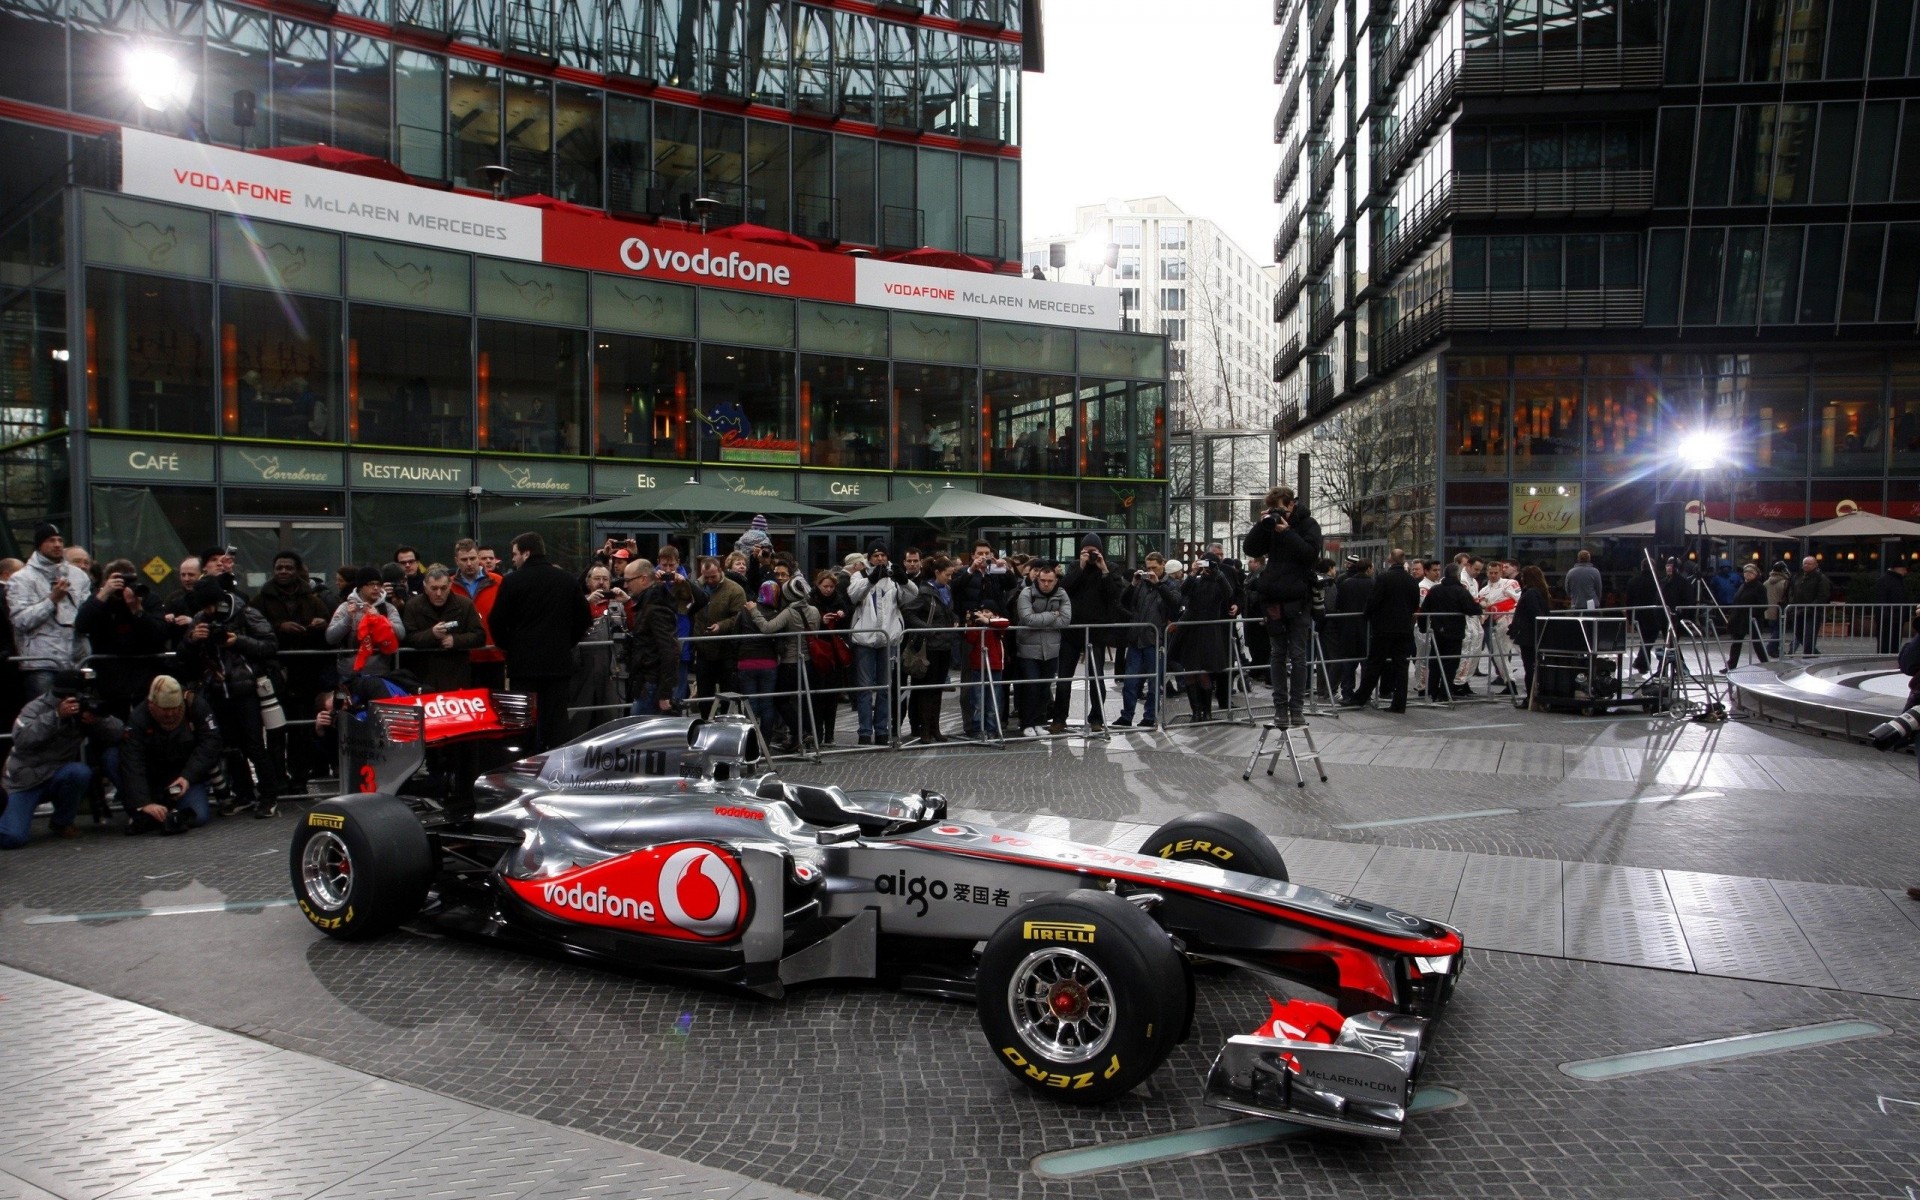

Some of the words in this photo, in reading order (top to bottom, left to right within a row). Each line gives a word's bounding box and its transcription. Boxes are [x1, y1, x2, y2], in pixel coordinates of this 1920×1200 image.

[174, 168, 292, 205] VODAFONE
[304, 194, 400, 223] McLAREN
[408, 212, 508, 241] MERCEDES
[652, 248, 791, 286] vodafone
[884, 283, 956, 301] VODAFONE
[962, 291, 1024, 308] McLAREN
[1028, 300, 1096, 315] MERCEDES
[128, 451, 179, 471] CAFÉ
[262, 465, 328, 482] Corroboree
[362, 462, 462, 482] RESTAURANT
[516, 476, 570, 491] Corroboree
[830, 481, 860, 496] CAFÉ
[1518, 500, 1574, 530] Josty
[414, 694, 487, 719] afone
[583, 745, 640, 773] Mobil
[360, 764, 377, 794] 3
[567, 773, 650, 792] Mercedes-Benz
[308, 812, 345, 830] PIRELLI
[713, 805, 765, 821] vodafone
[1158, 839, 1235, 861] ZERO
[543, 882, 656, 923] vodafone
[874, 869, 949, 918] aigo
[953, 882, 1011, 908] 爱国者
[300, 899, 342, 929] ZERO
[345, 905, 354, 923] P
[1023, 921, 1097, 943] PIRELLI
[1002, 1047, 1095, 1090] ZERO
[1103, 1053, 1121, 1080] P
